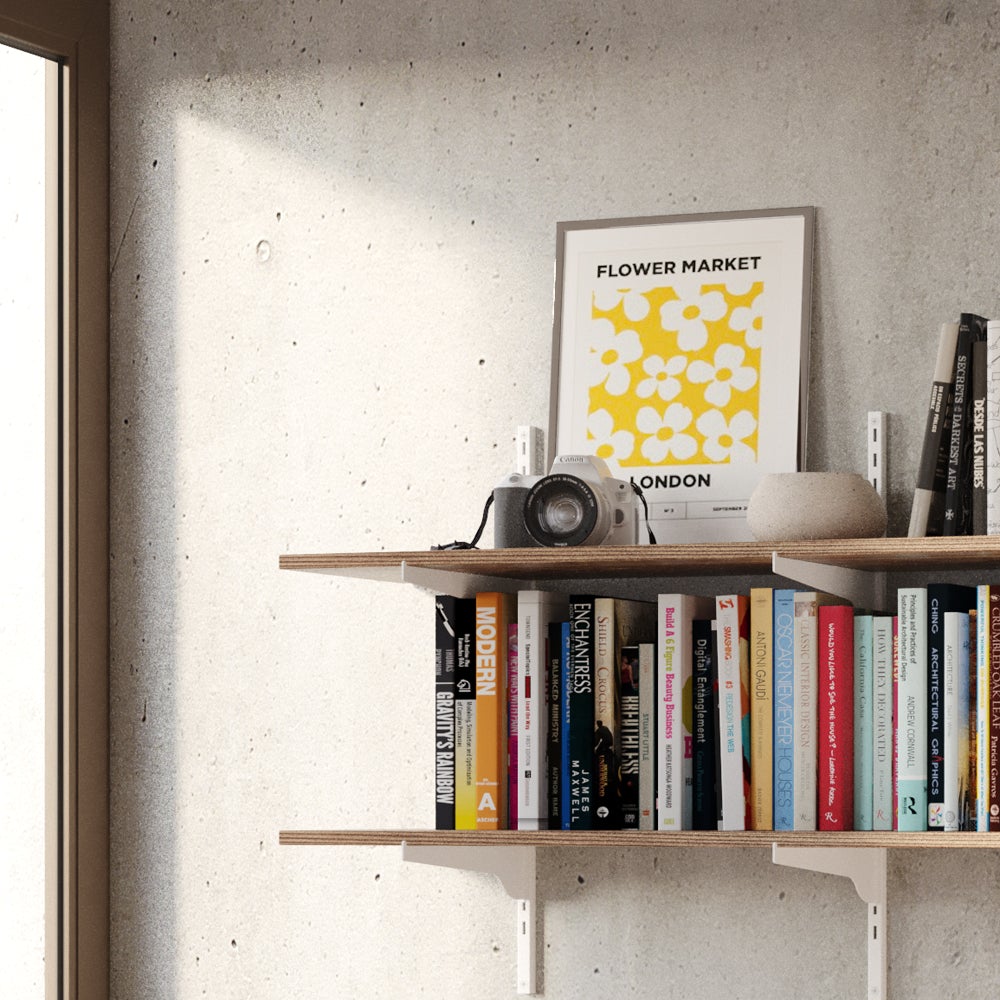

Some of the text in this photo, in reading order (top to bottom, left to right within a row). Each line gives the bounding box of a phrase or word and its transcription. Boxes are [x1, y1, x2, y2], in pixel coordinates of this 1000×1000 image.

[597, 256, 762, 278] FLOWER MARKET
[954, 355, 967, 404] SECRETS
[949, 414, 962, 465] DARKEST
[974, 434, 985, 454] LAS
[947, 467, 957, 490] ART
[664, 607, 675, 628] Build
[828, 622, 836, 648] WOULD
[476, 606, 497, 696] MODERN
[573, 603, 591, 694] ENCHANTRESS
[694, 638, 707, 671] Digital
[723, 626, 732, 660] SMASHING
[800, 619, 810, 660] CLASSIC
[828, 648, 836, 661] YOU
[597, 616, 609, 714] SHIELD CROCUS
[664, 646, 675, 672] Figure
[756, 631, 769, 701] ANTONI GAUDÍ
[859, 645, 867, 693] California
[664, 673, 675, 702] Beauty
[800, 662, 810, 708] INTERIOR
[828, 680, 836, 690] TO
[877, 629, 886, 762] HOW THEY DECORATED
[931, 598, 944, 795] CHING ARCHITECTURAL GRAPHICS
[664, 704, 675, 739] Business
[694, 676, 707, 744] Entanglement
[777, 613, 793, 808] OSCAR NIEMEYER HOUSES
[828, 706, 836, 720] THE
[859, 696, 867, 719] Casa
[436, 692, 455, 804] GRAVITY'S RAINBOW
[551, 658, 559, 817] BALANCED MINISTRY AUTHOR NAME
[726, 724, 734, 737] THE
[727, 739, 735, 753] WEB
[800, 711, 810, 748] DESIGN
[906, 695, 915, 768] ANDREW CORNWALL
[991, 736, 999, 766] Patricia
[478, 792, 496, 810] A
[571, 760, 580, 823] MAXWELL
[581, 769, 590, 812] JAMES
